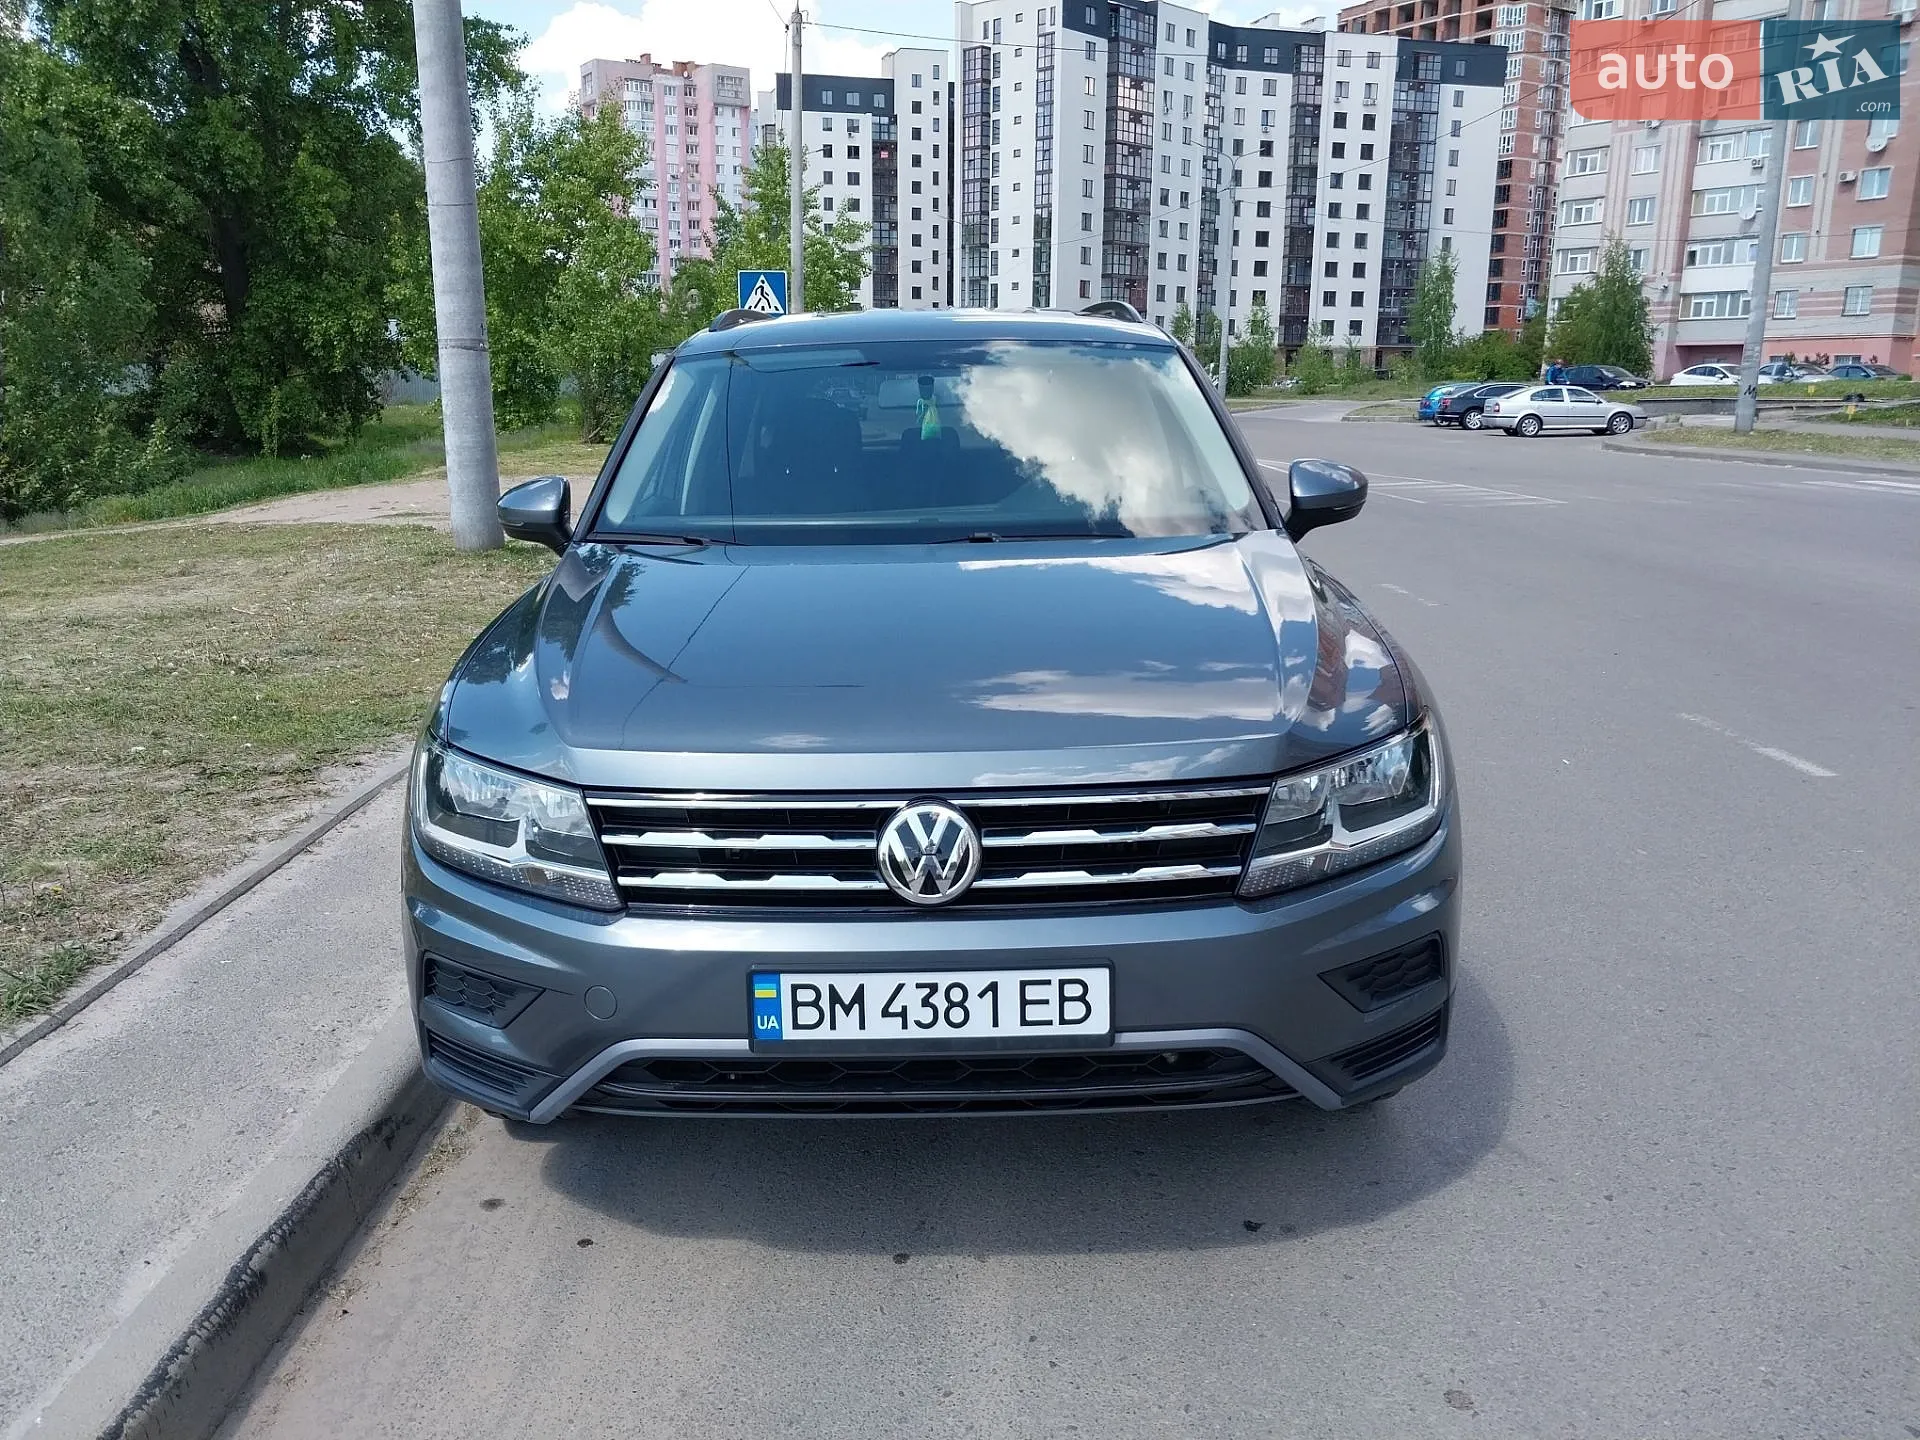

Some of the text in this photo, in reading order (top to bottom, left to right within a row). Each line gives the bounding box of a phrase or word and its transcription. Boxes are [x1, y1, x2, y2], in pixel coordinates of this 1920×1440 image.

[879, 804, 981, 904] VW
[757, 1015, 780, 1030] UA
[790, 978, 1093, 1031] BM 4381 EB
